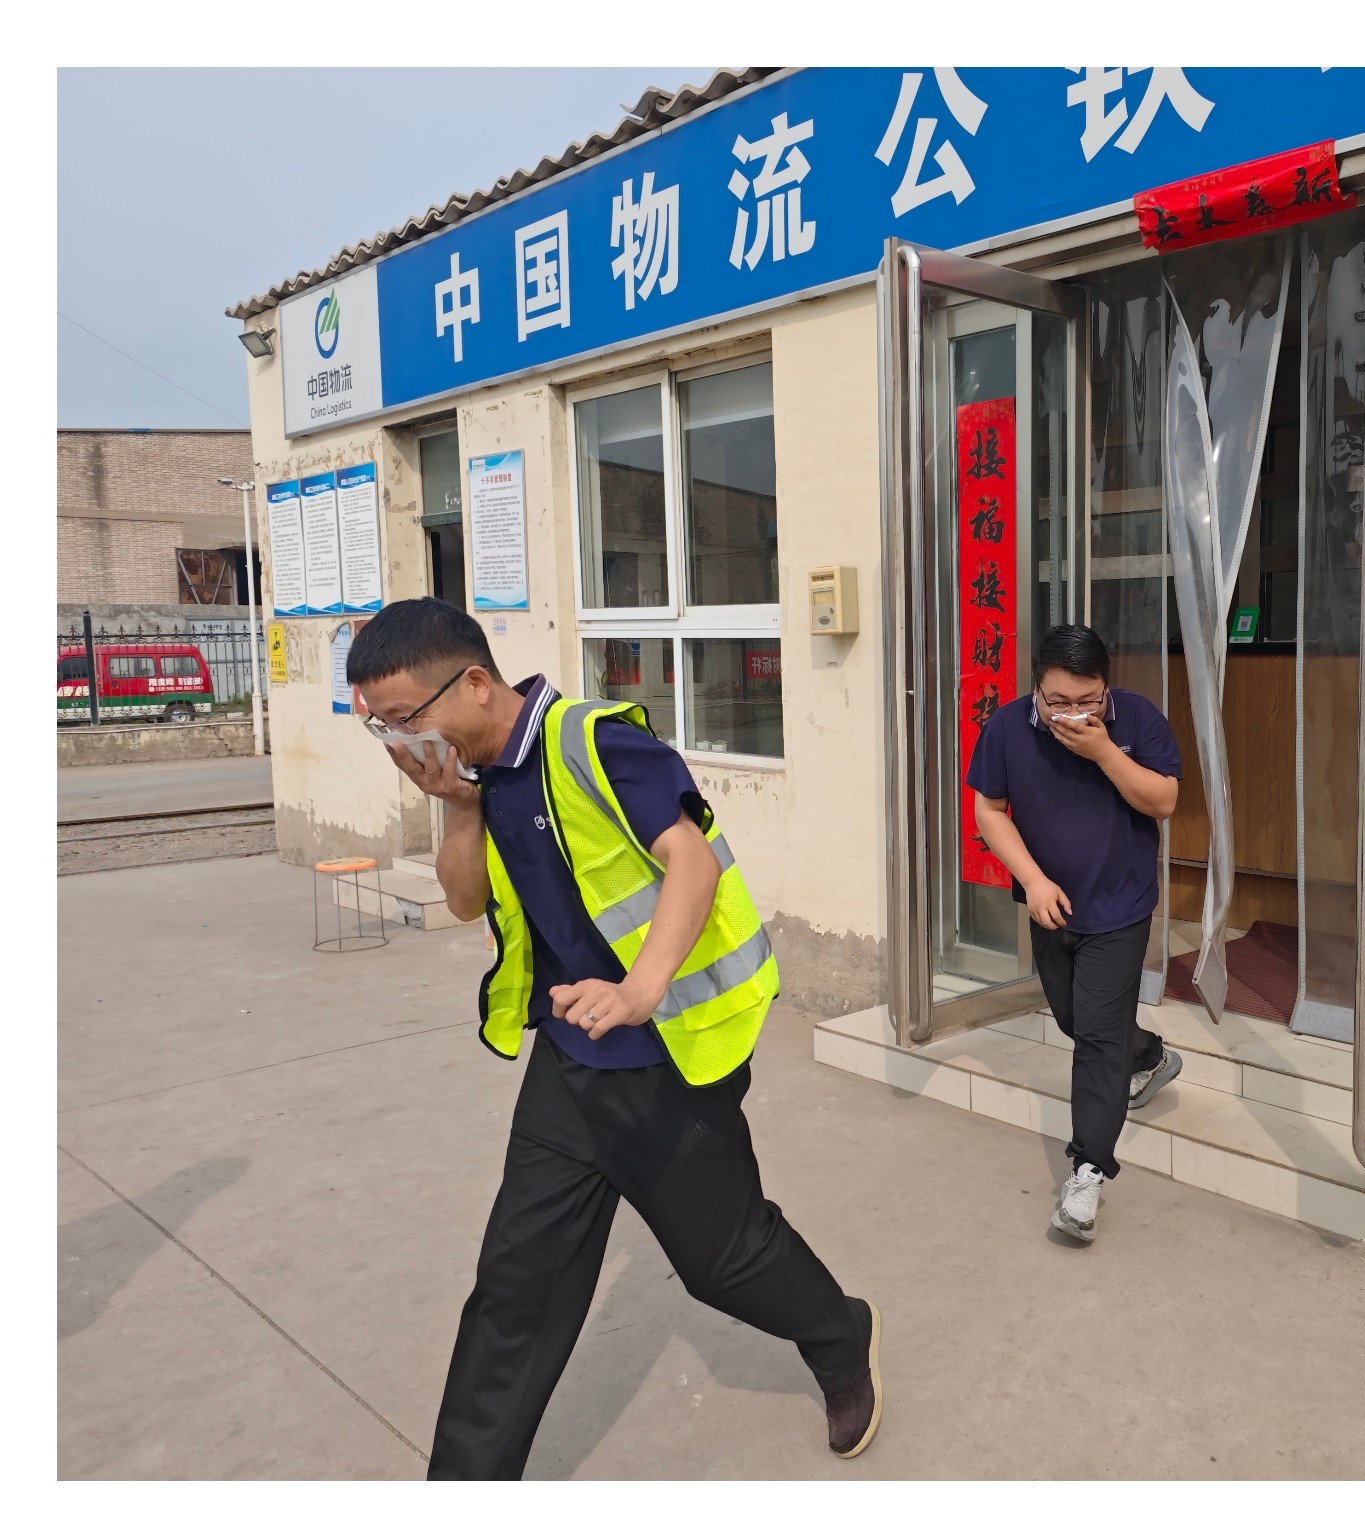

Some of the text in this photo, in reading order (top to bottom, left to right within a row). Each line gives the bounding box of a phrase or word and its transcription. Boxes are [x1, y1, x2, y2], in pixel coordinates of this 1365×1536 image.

[307, 364, 352, 400] 中国物流
[310, 400, 352, 419] China Logistics
